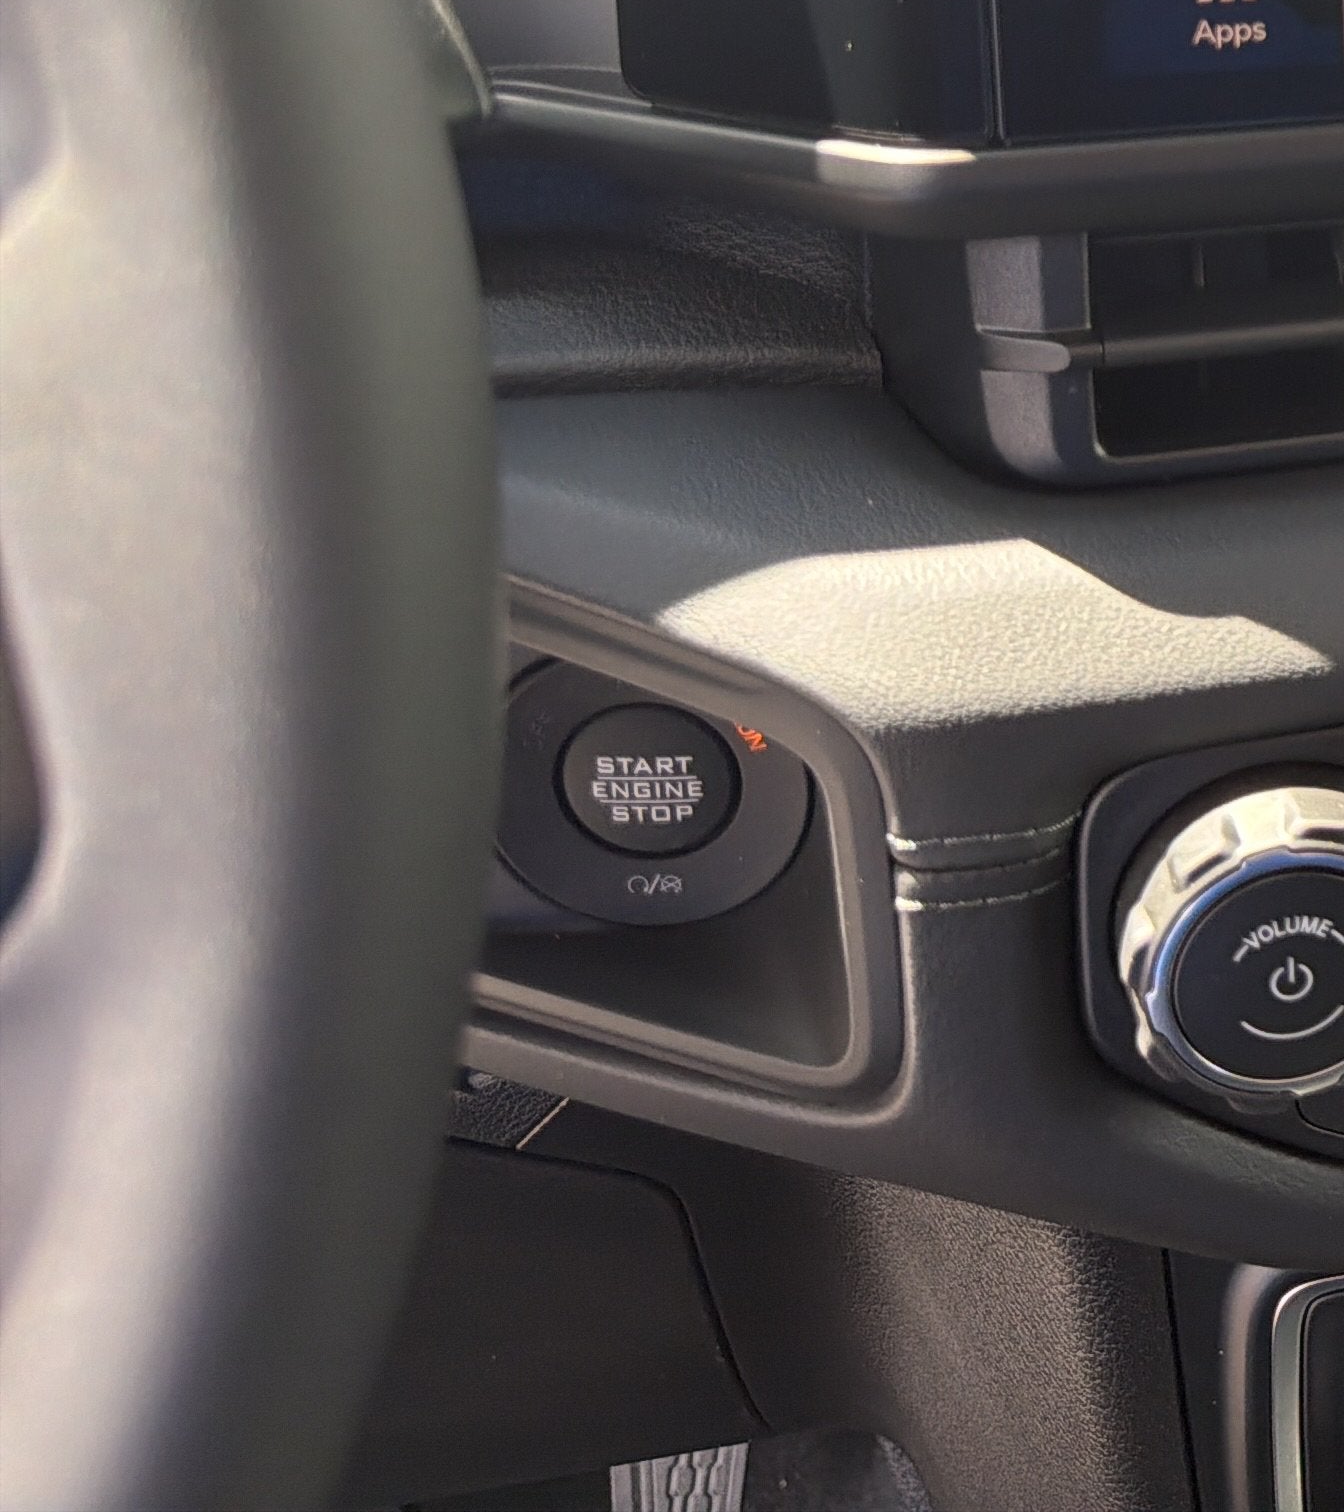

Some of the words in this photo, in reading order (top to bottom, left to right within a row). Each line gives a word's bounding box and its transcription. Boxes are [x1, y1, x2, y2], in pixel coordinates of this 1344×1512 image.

[1193, 20, 1266, 49] Apps
[596, 756, 693, 775] START
[591, 780, 704, 799] ENGINE
[612, 805, 694, 823] STOP
[1243, 915, 1333, 951] VOLUME
